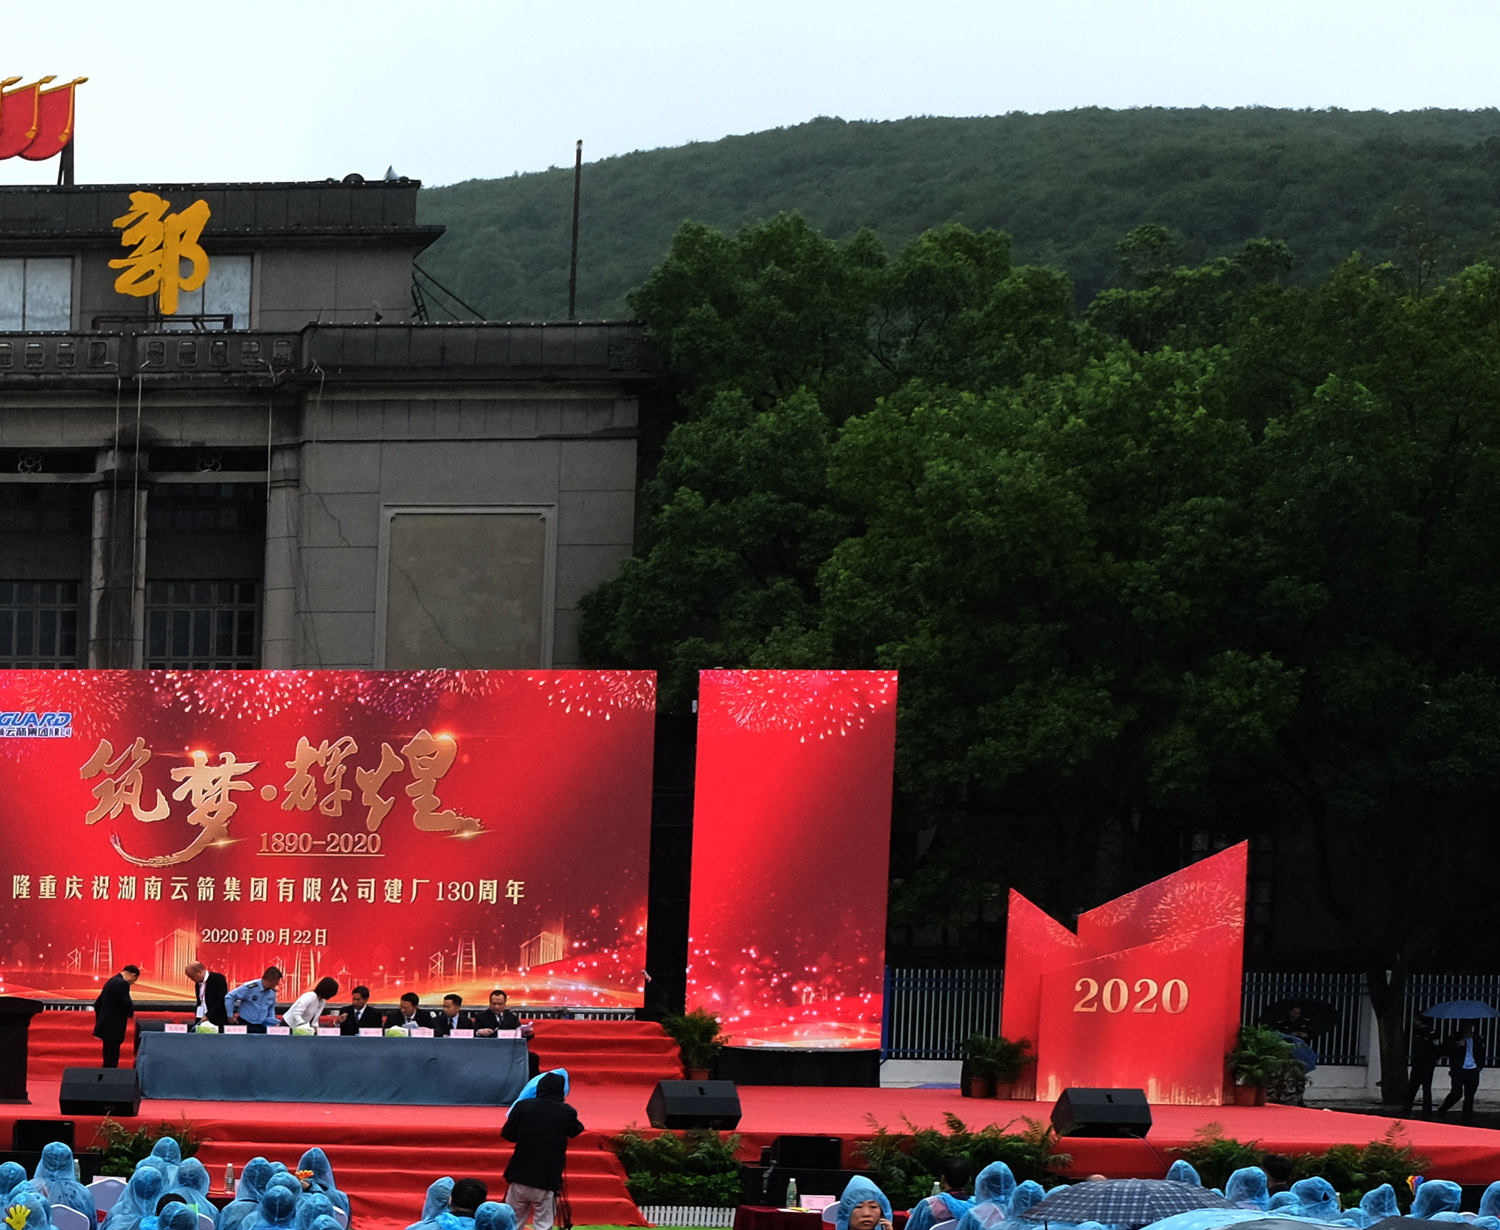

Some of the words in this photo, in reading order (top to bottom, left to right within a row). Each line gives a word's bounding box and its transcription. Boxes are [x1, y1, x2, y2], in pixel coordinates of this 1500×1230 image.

[259, 832, 382, 853] 1890-2020
[12, 874, 525, 905] 隆重庆祝湖南云箭集团有限公司建厂130周年
[201, 927, 328, 946] 2020年09月22日
[1073, 978, 1189, 1014] 2020
